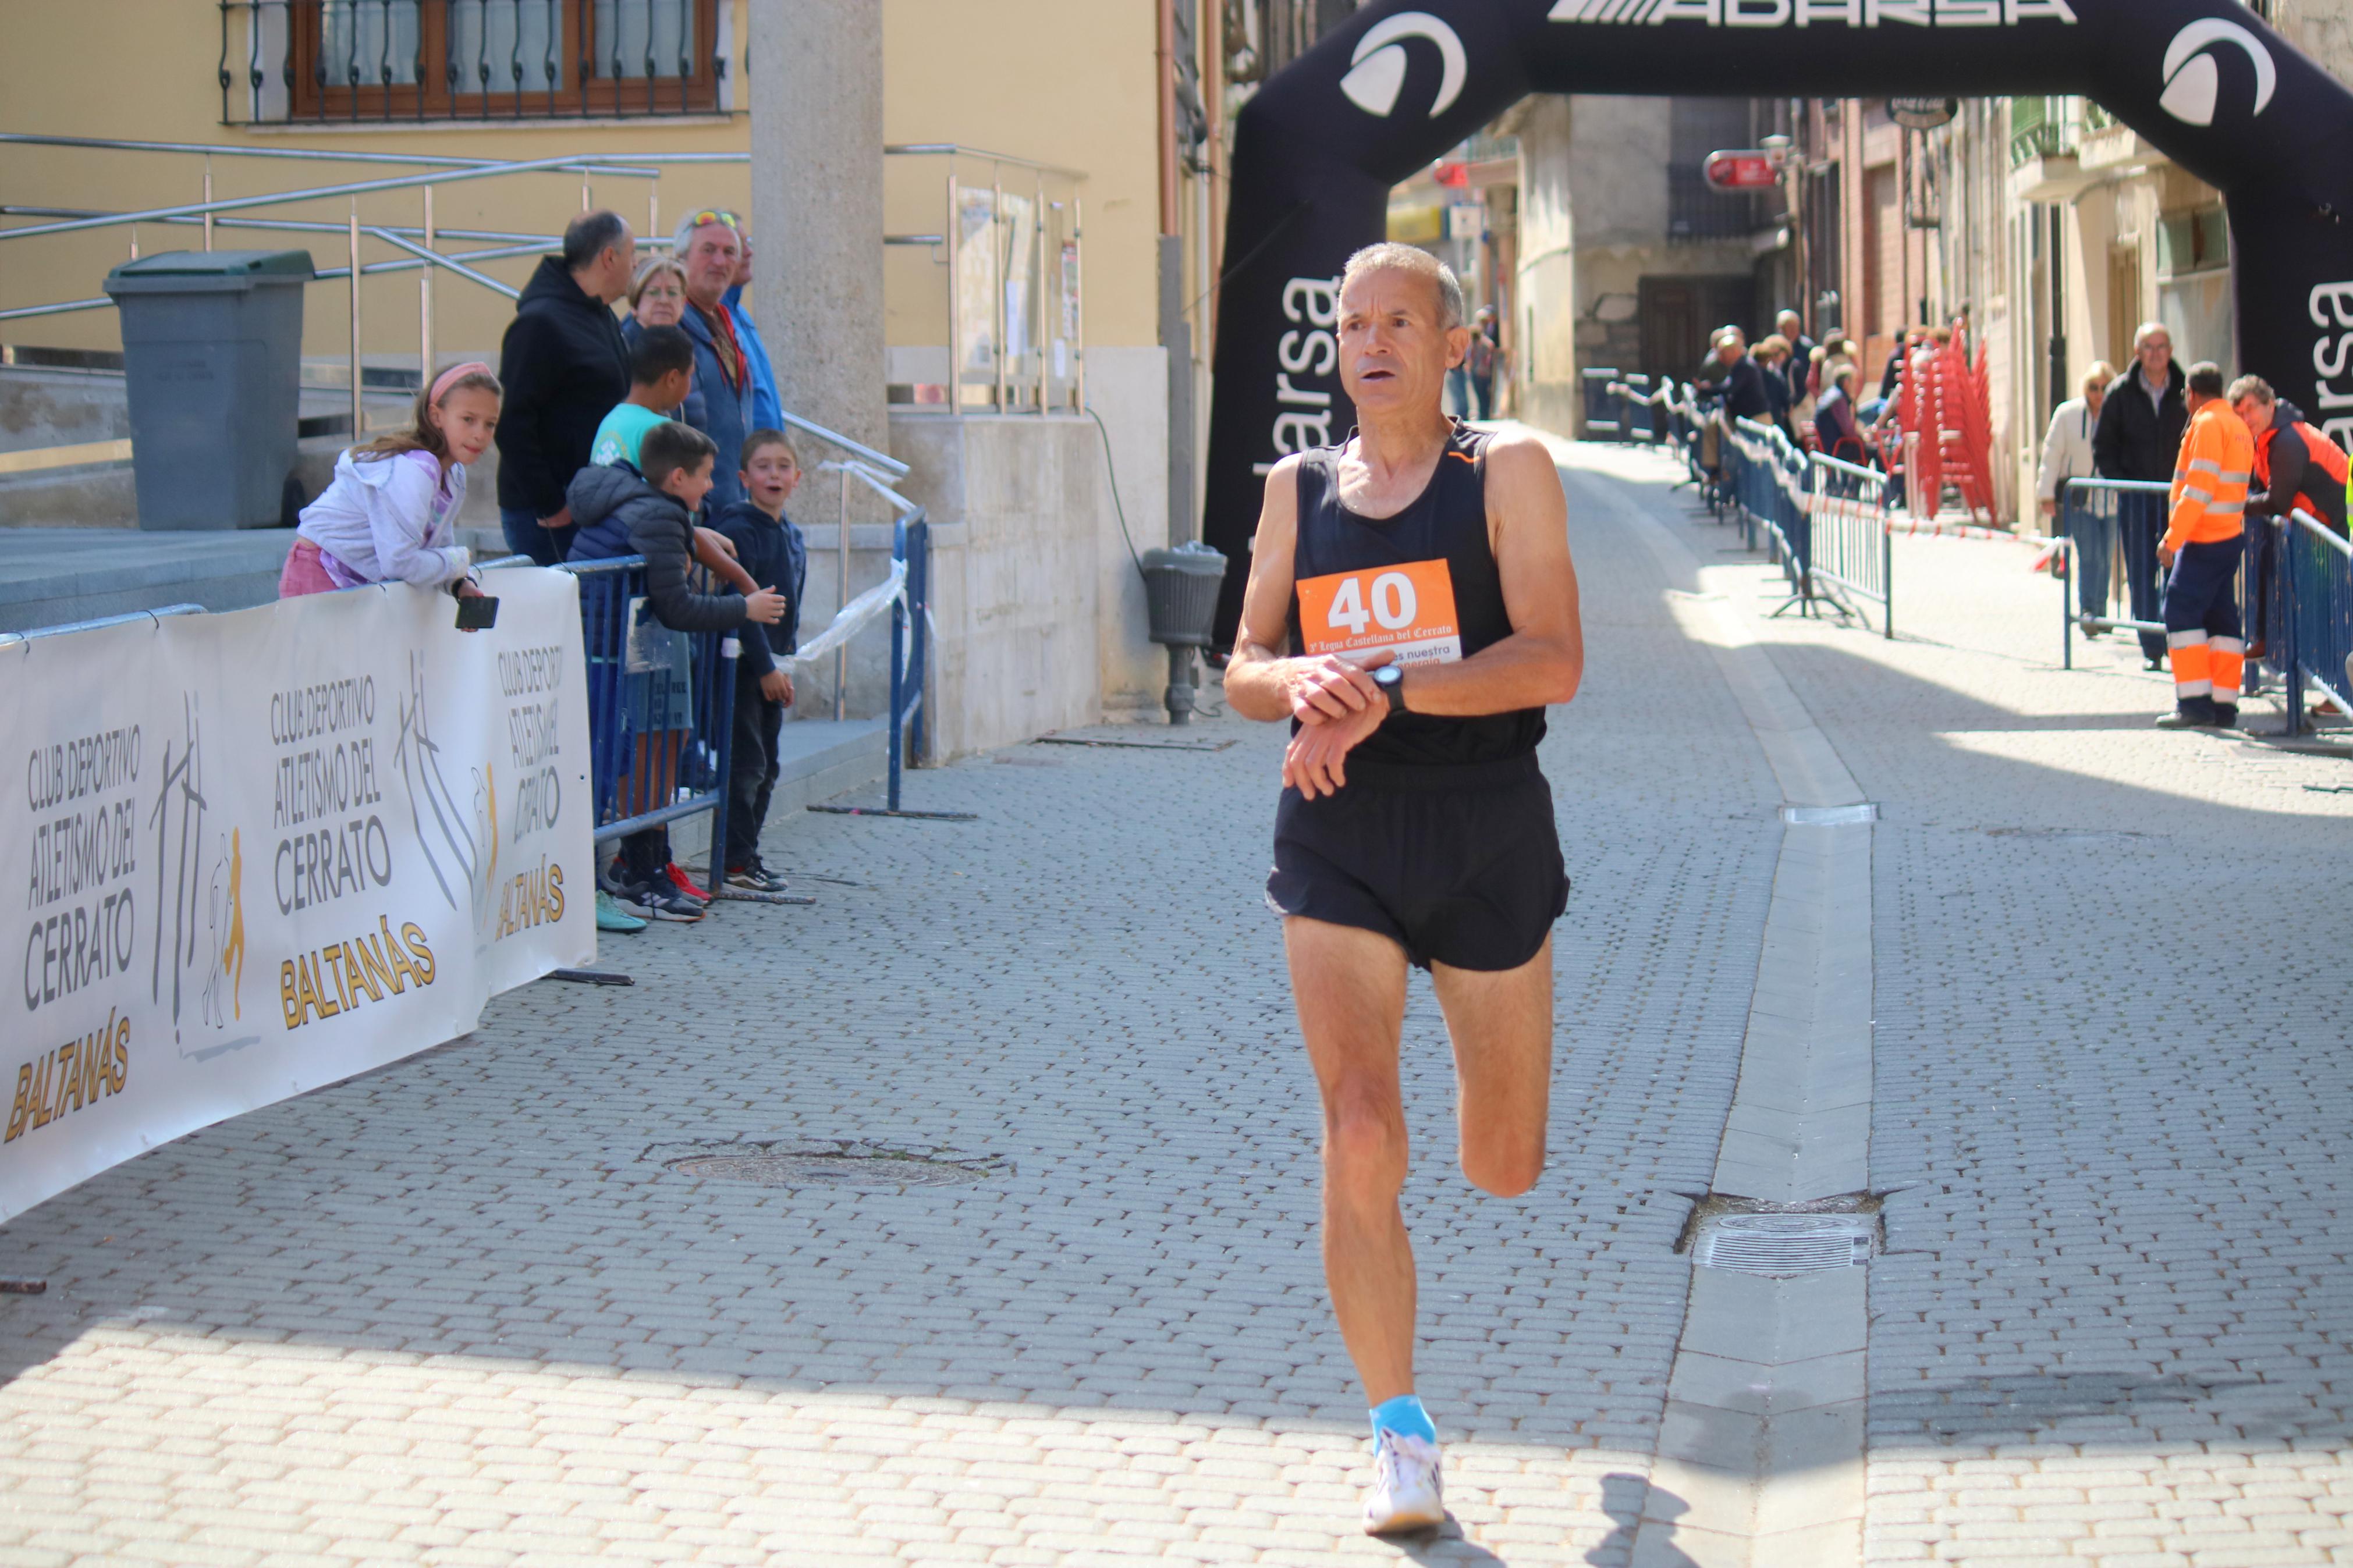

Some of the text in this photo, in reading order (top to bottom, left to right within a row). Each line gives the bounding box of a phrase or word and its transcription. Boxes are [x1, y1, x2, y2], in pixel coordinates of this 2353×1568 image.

[1319, 641, 1343, 652] Legua
[1346, 634, 1394, 648] Castellana
[1396, 630, 1411, 640] del
[1413, 625, 1452, 638] Cerrato
[1328, 572, 1417, 635] 40
[498, 650, 523, 697] CLUB
[1407, 646, 1450, 659] nuestra
[271, 674, 374, 746] CLUB DEPORTIVO
[28, 724, 140, 812] CLUB DEPORTIVO
[274, 737, 381, 829] ATLETISMO DEL
[29, 797, 136, 908] ATLETISMO DEL
[275, 815, 391, 916] CERRATO
[24, 887, 134, 1011] CERRATO
[281, 914, 435, 1030] BALTANÁS
[4, 1006, 130, 1144] BALTANÁS
